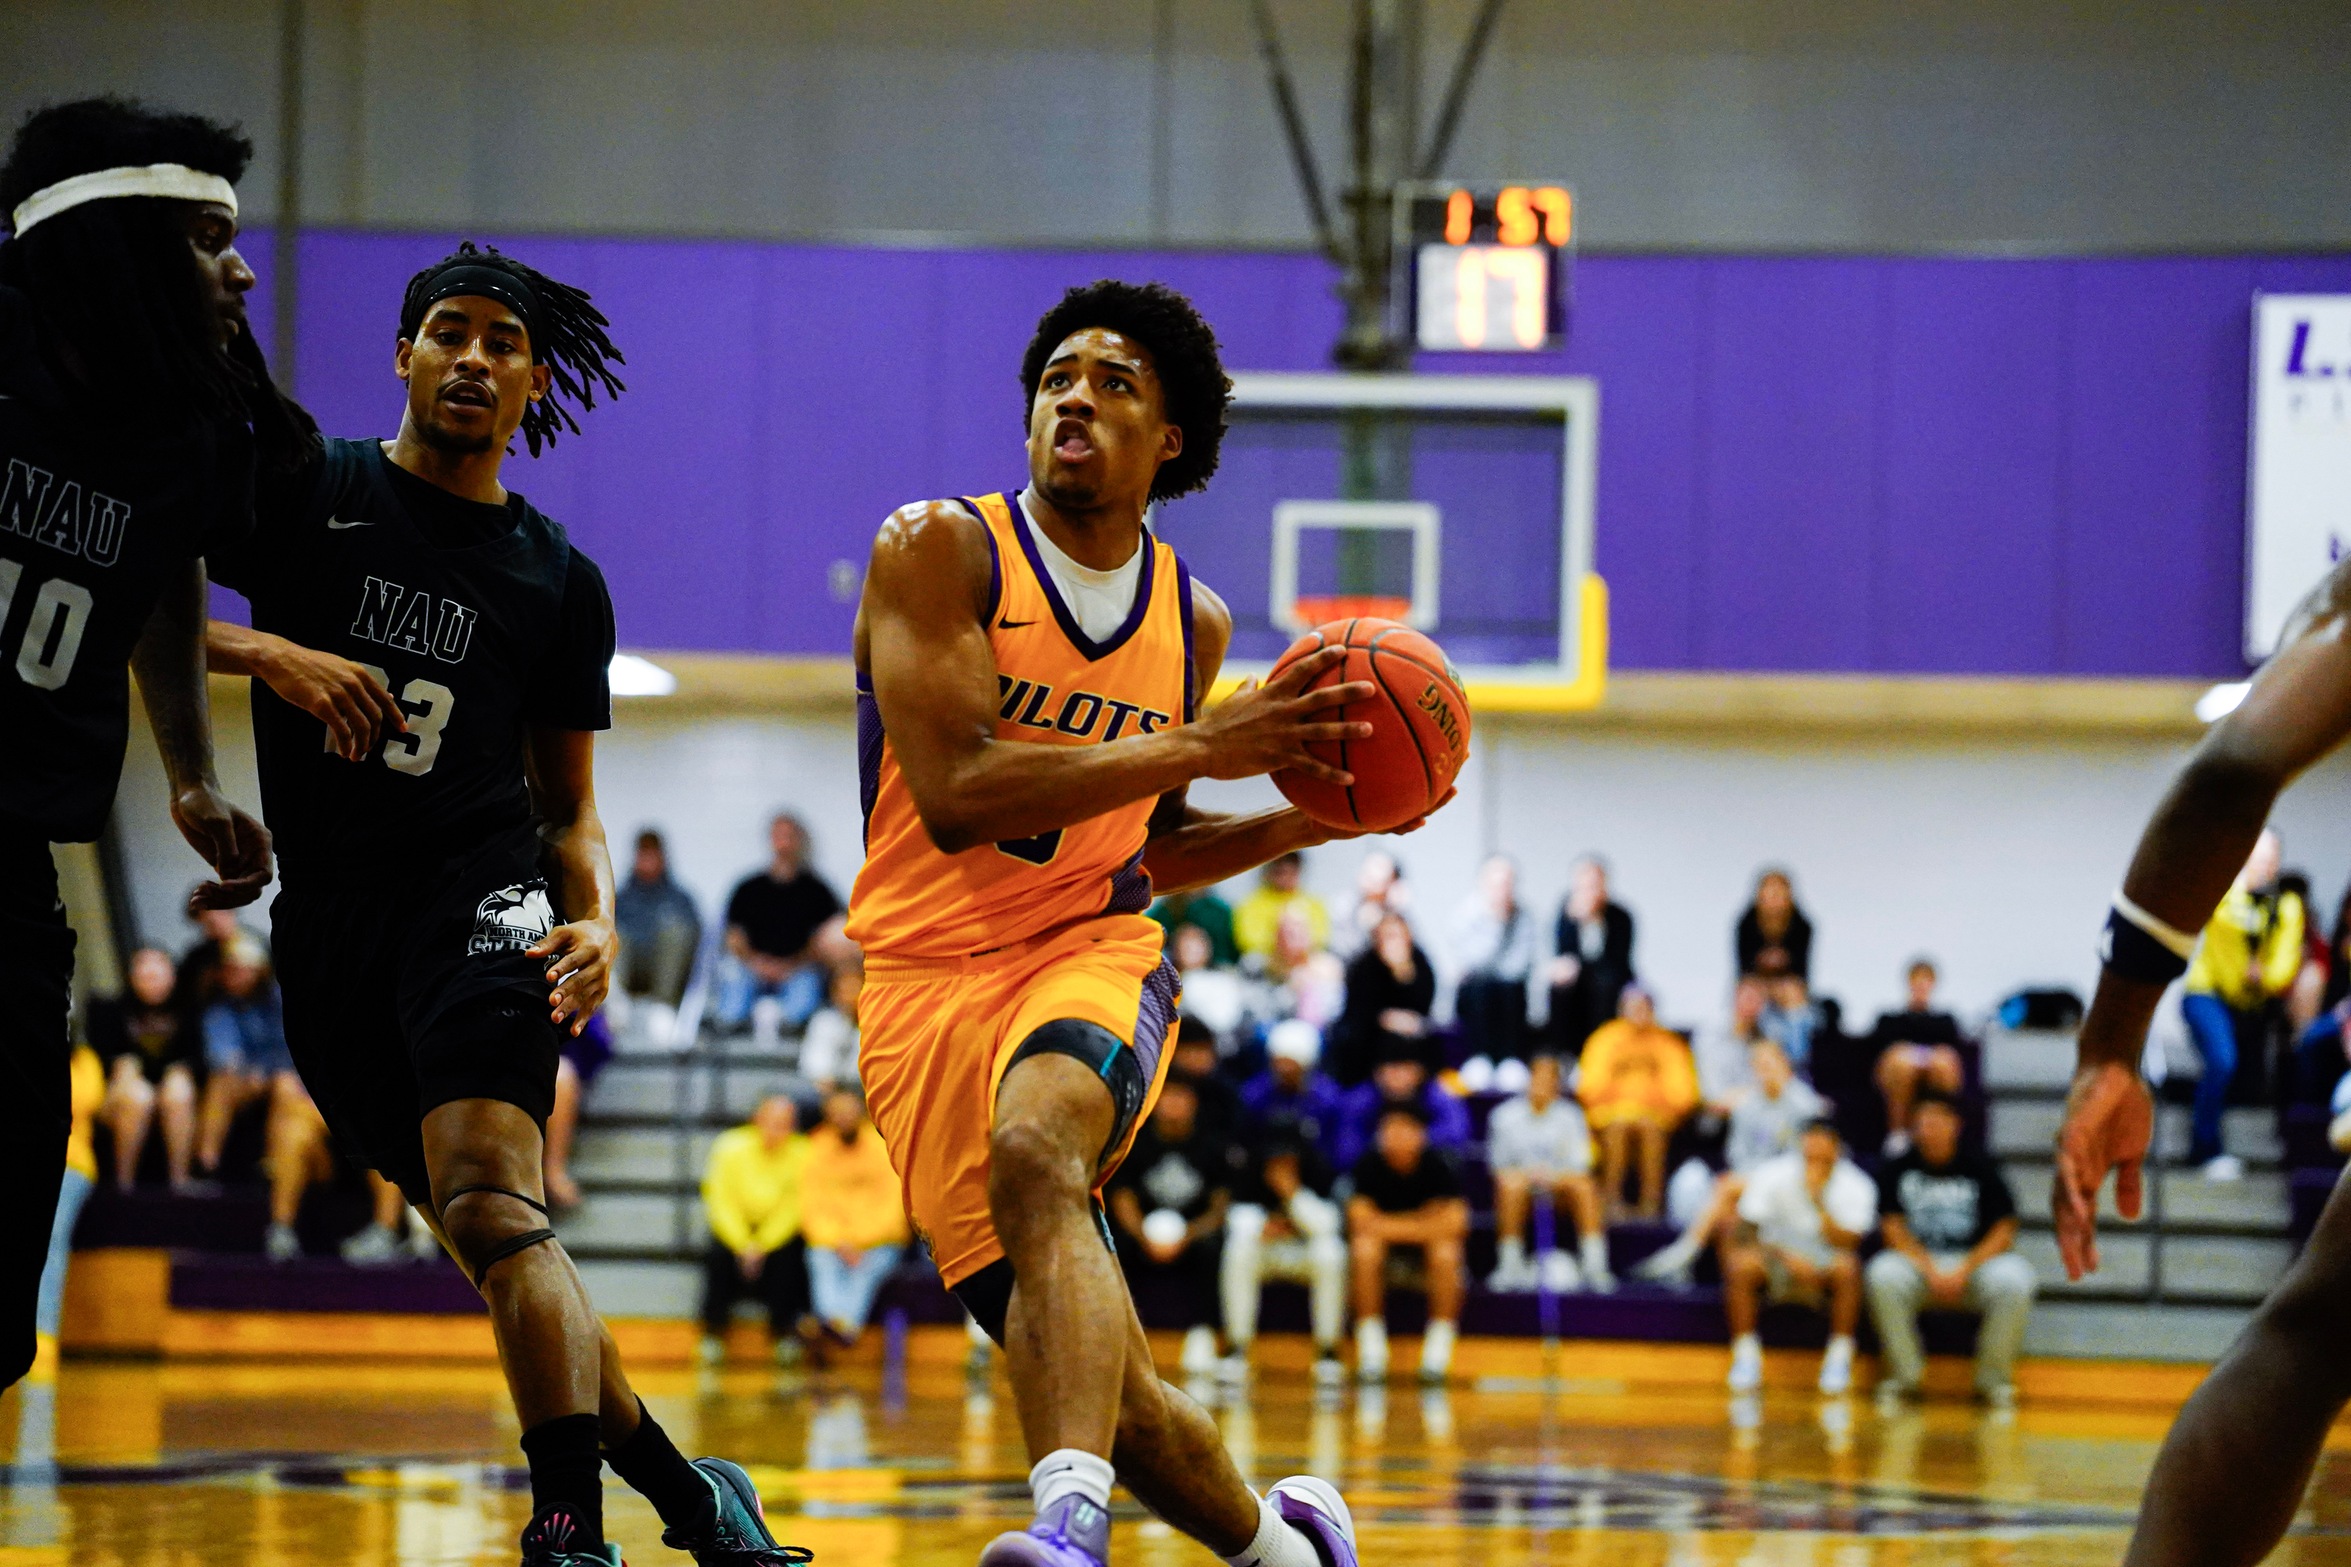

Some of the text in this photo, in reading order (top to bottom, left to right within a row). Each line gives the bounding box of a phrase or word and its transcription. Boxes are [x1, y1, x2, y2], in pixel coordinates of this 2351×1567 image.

[1456, 248, 1544, 348] 17
[0, 458, 131, 567] NAU
[350, 575, 478, 664] NAU
[488, 925, 526, 940] NORTH
